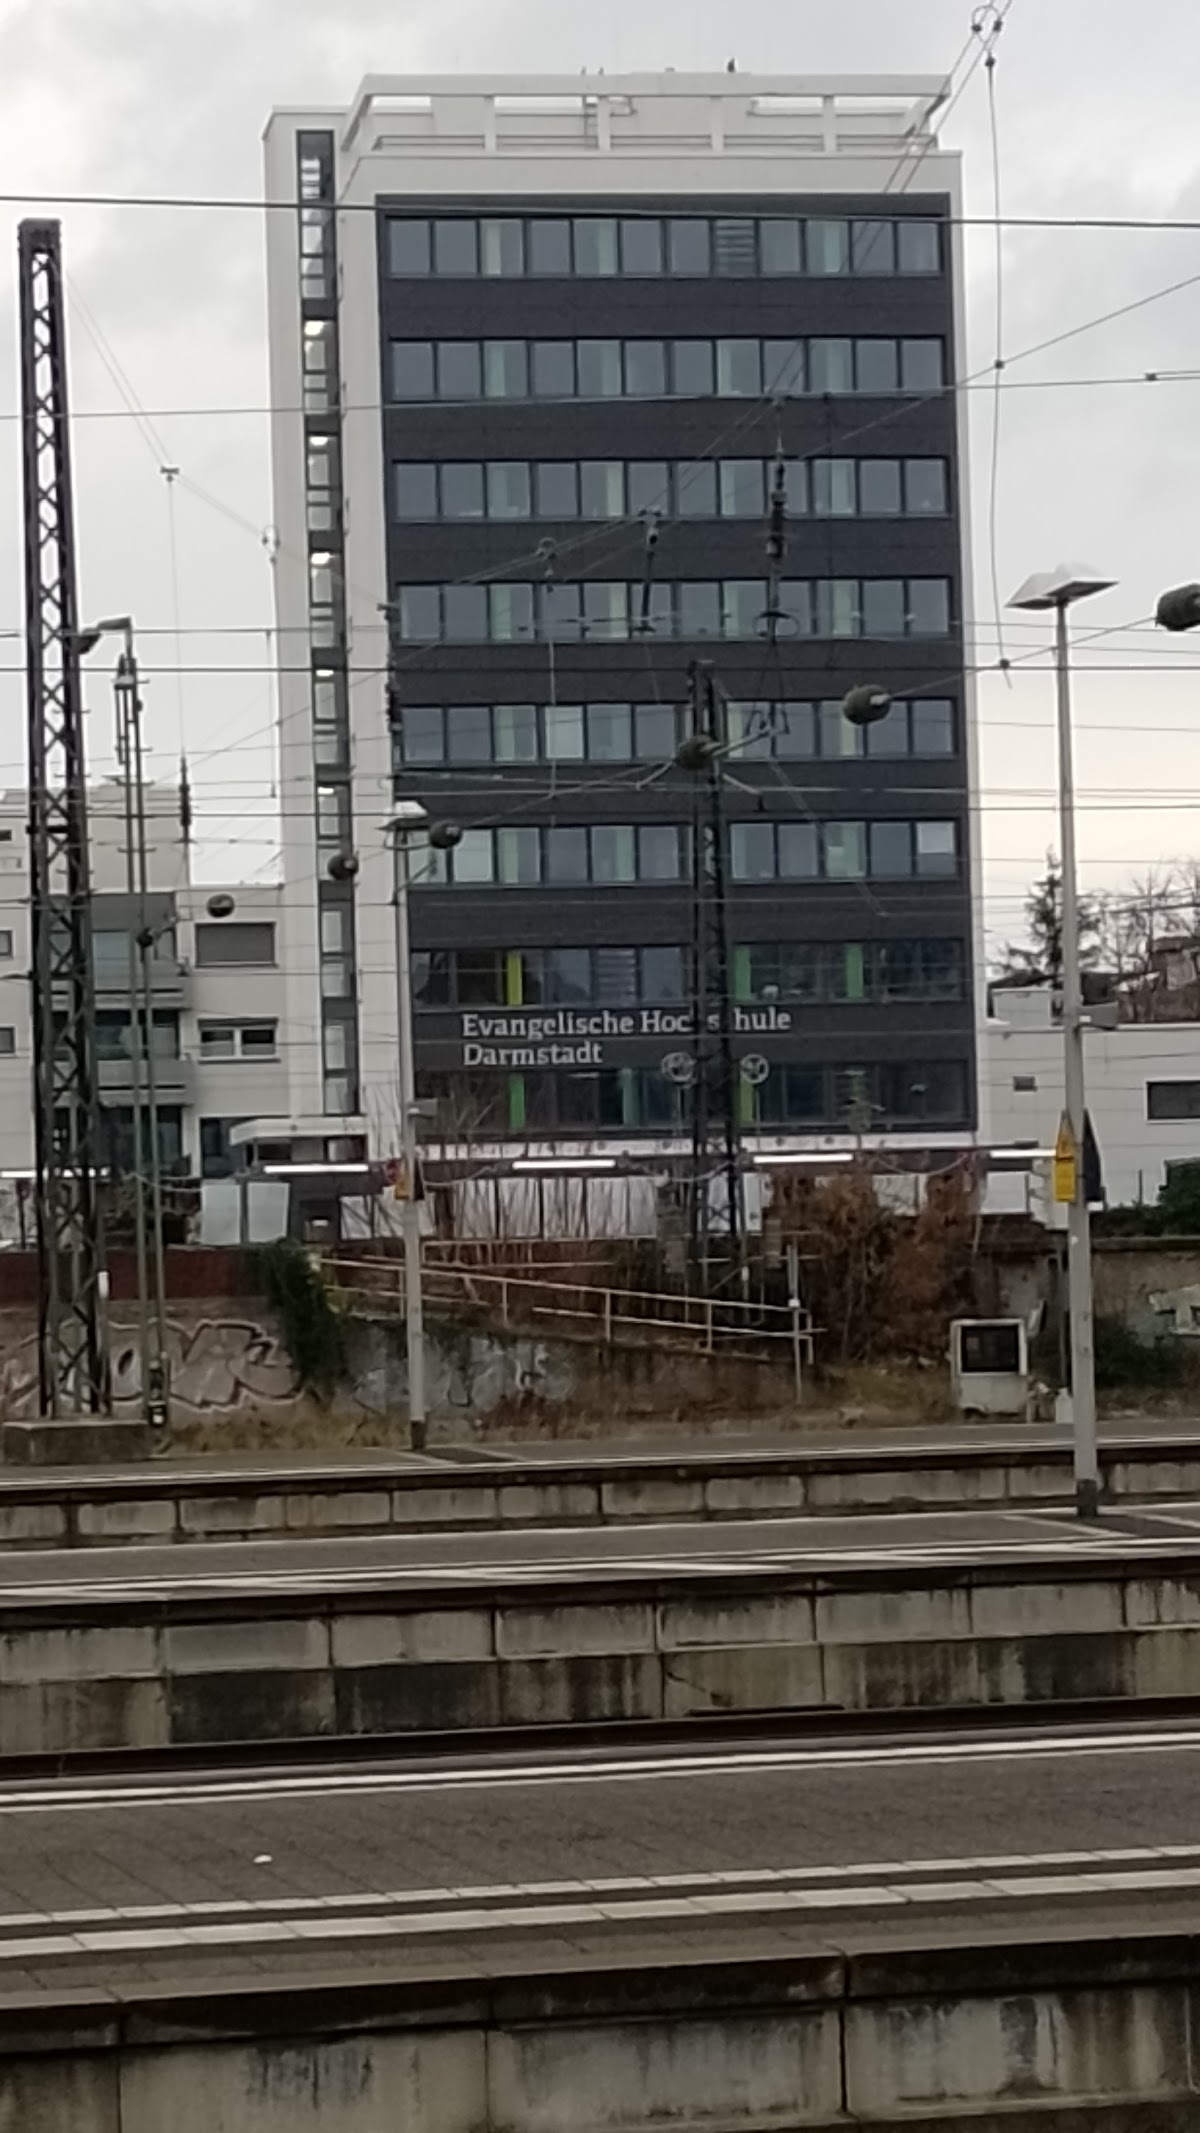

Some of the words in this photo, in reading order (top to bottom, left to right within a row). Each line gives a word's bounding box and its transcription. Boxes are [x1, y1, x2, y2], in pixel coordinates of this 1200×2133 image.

[462, 1010, 634, 1040] Evangelische
[639, 1006, 792, 1032] Hocshule
[463, 1041, 603, 1066] Darmstadt
